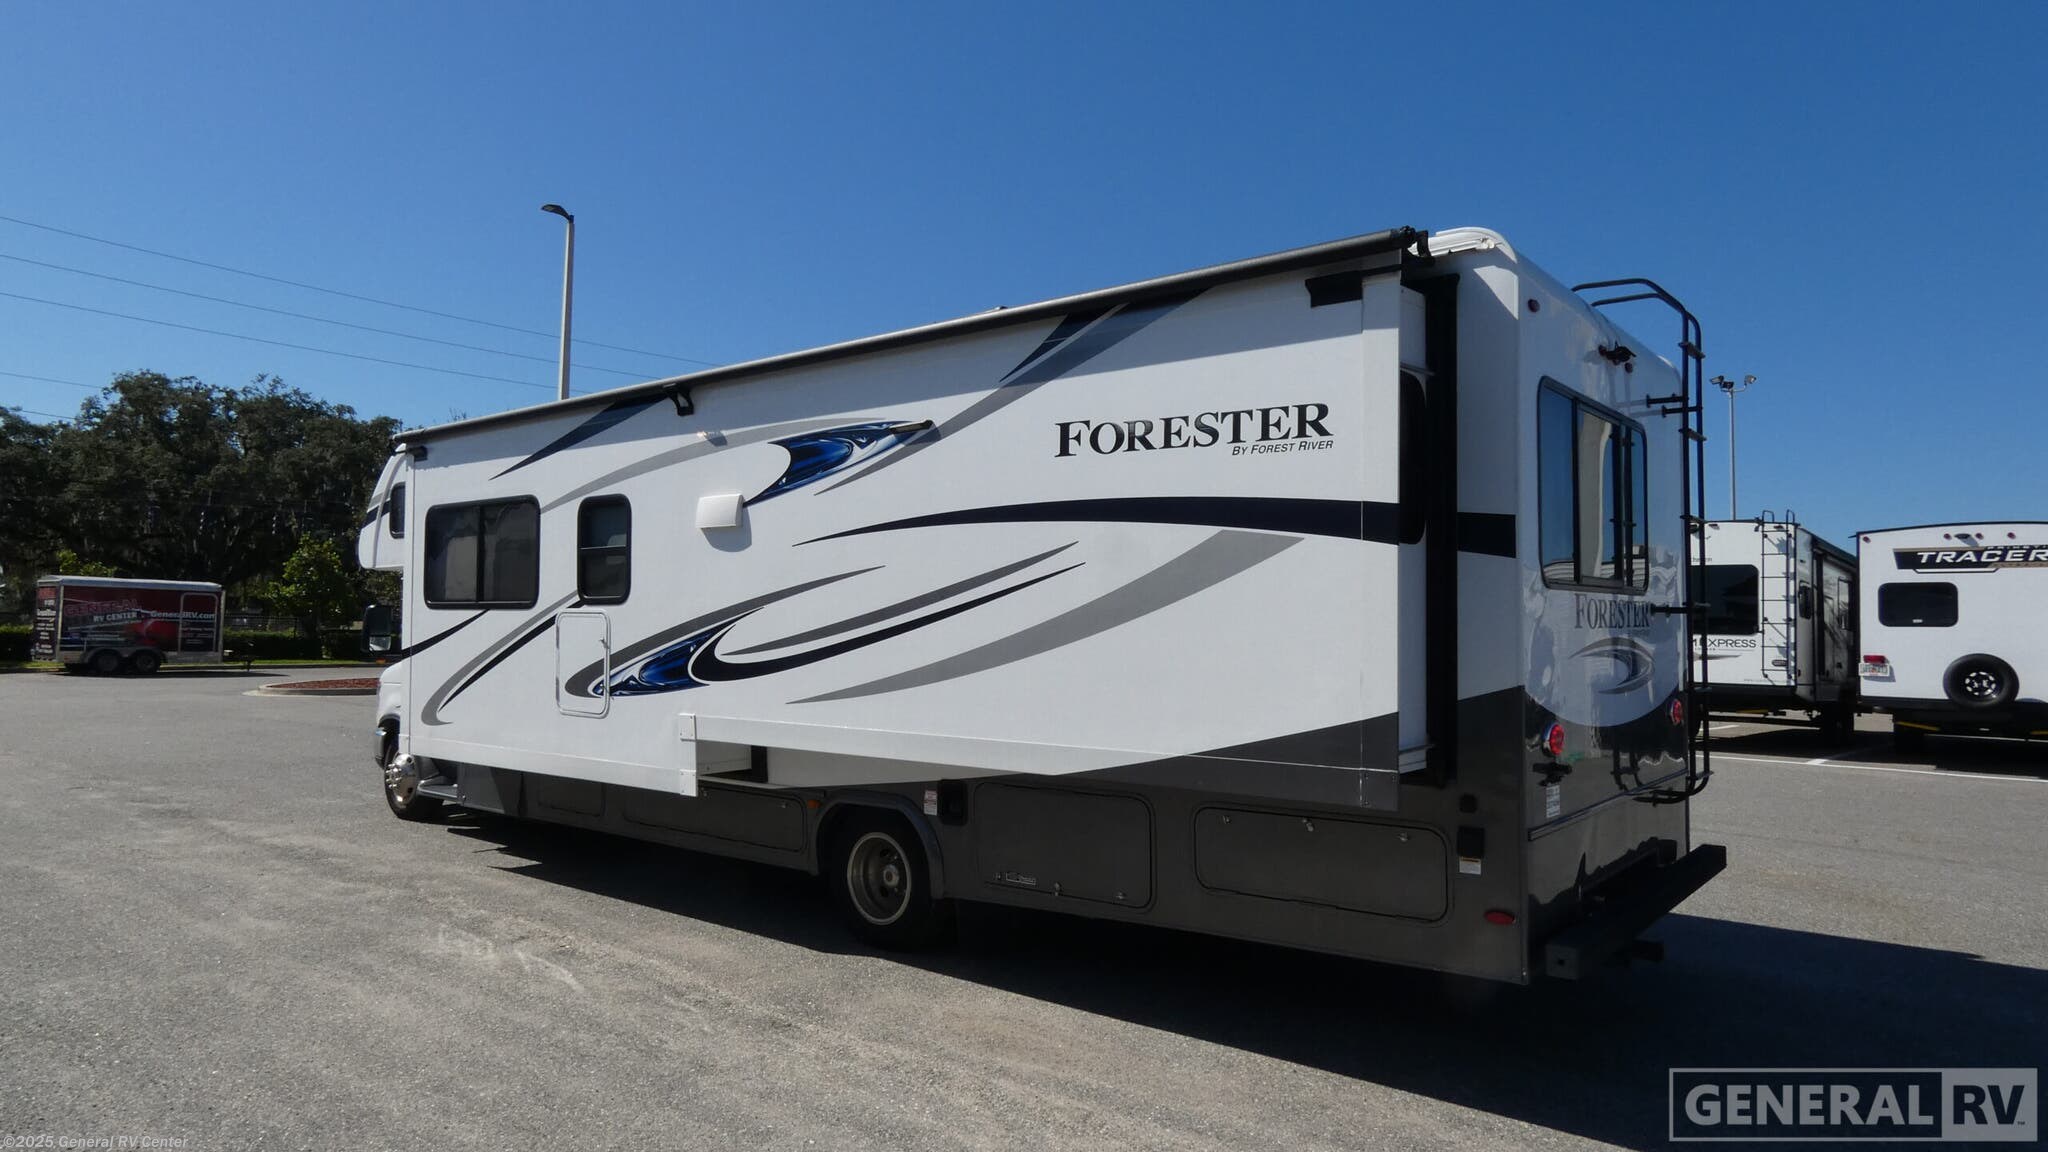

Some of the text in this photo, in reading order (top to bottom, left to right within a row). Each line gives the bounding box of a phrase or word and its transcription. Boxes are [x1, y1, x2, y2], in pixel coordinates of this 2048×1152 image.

[1054, 403, 1335, 458] FORESTER
[1232, 440, 1334, 456] BY FOREST RIVER
[1917, 550, 2048, 564] TRACER
[106, 611, 138, 622] CENTER
[1574, 593, 1650, 629] FORESTER
[1700, 638, 1757, 648] XPRESS
